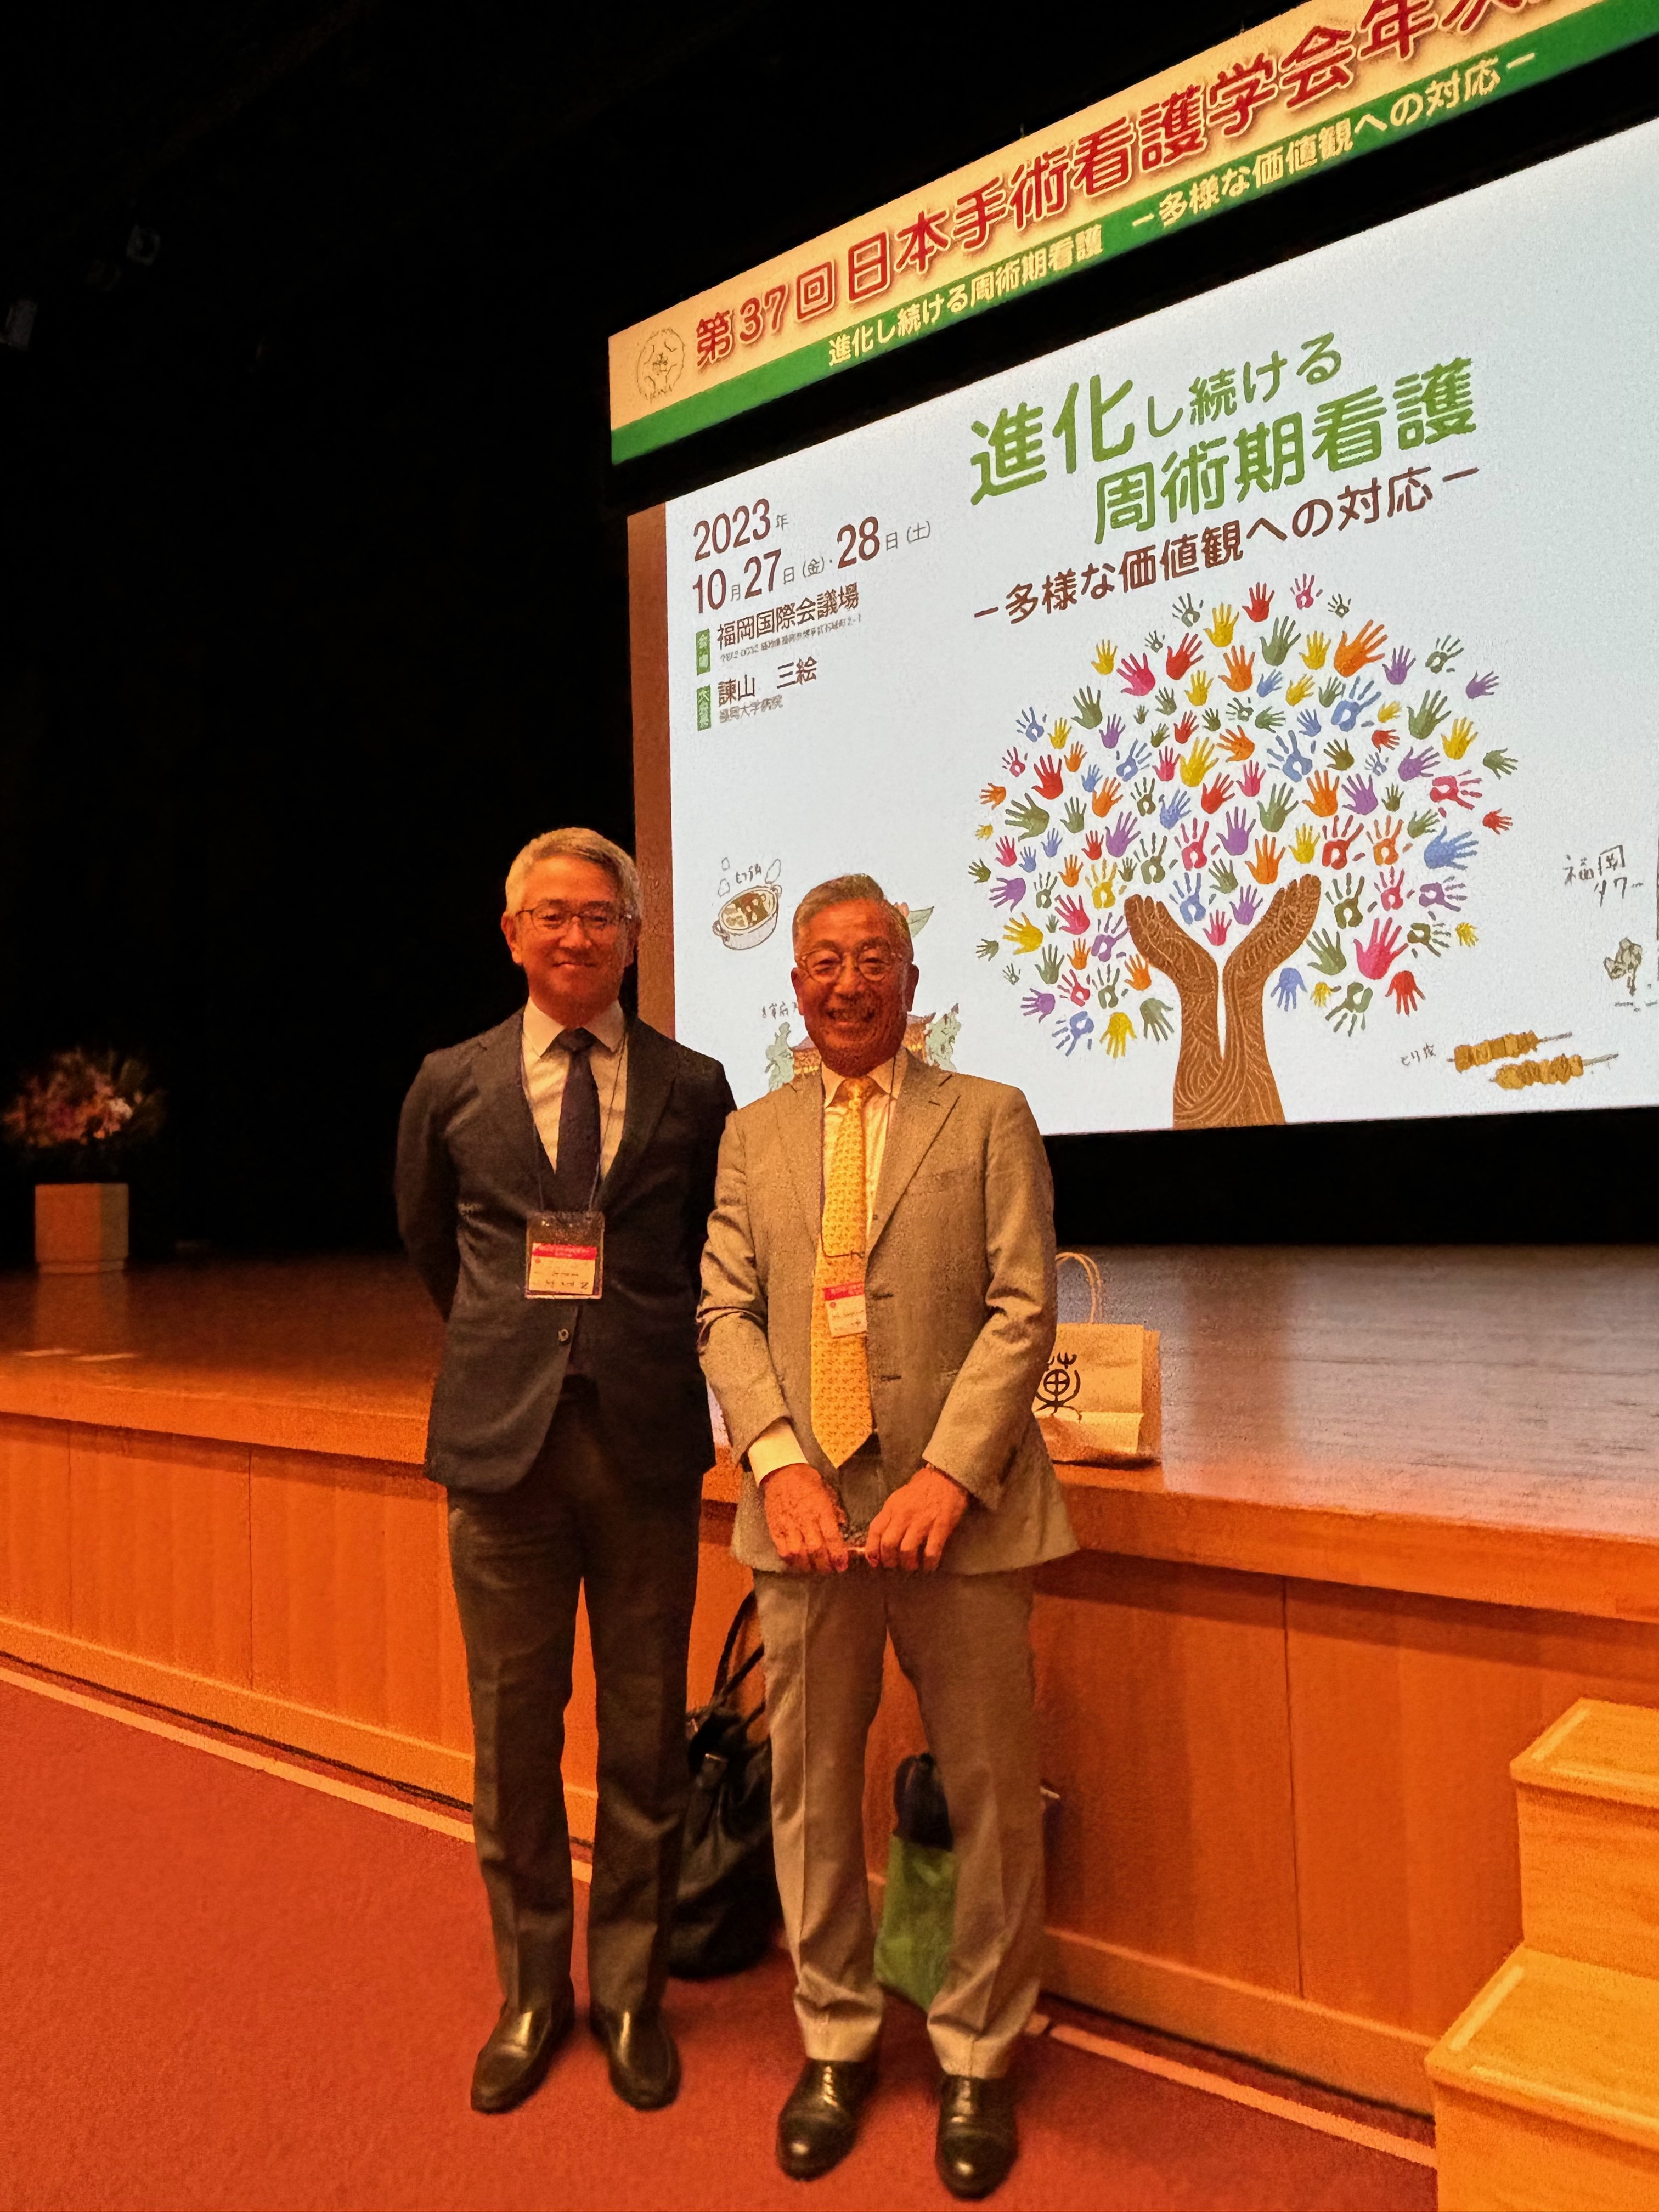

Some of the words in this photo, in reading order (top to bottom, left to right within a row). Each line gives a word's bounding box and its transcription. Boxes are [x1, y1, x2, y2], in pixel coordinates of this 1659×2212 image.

[829, 224, 1103, 366] 進化し続ける周術期看護
[970, 332, 1342, 505] 進化し続ける
[1095, 357, 1476, 545] 周術期看護
[717, 582, 860, 650] 福岡国際会議場
[776, 656, 818, 690] 三絵
